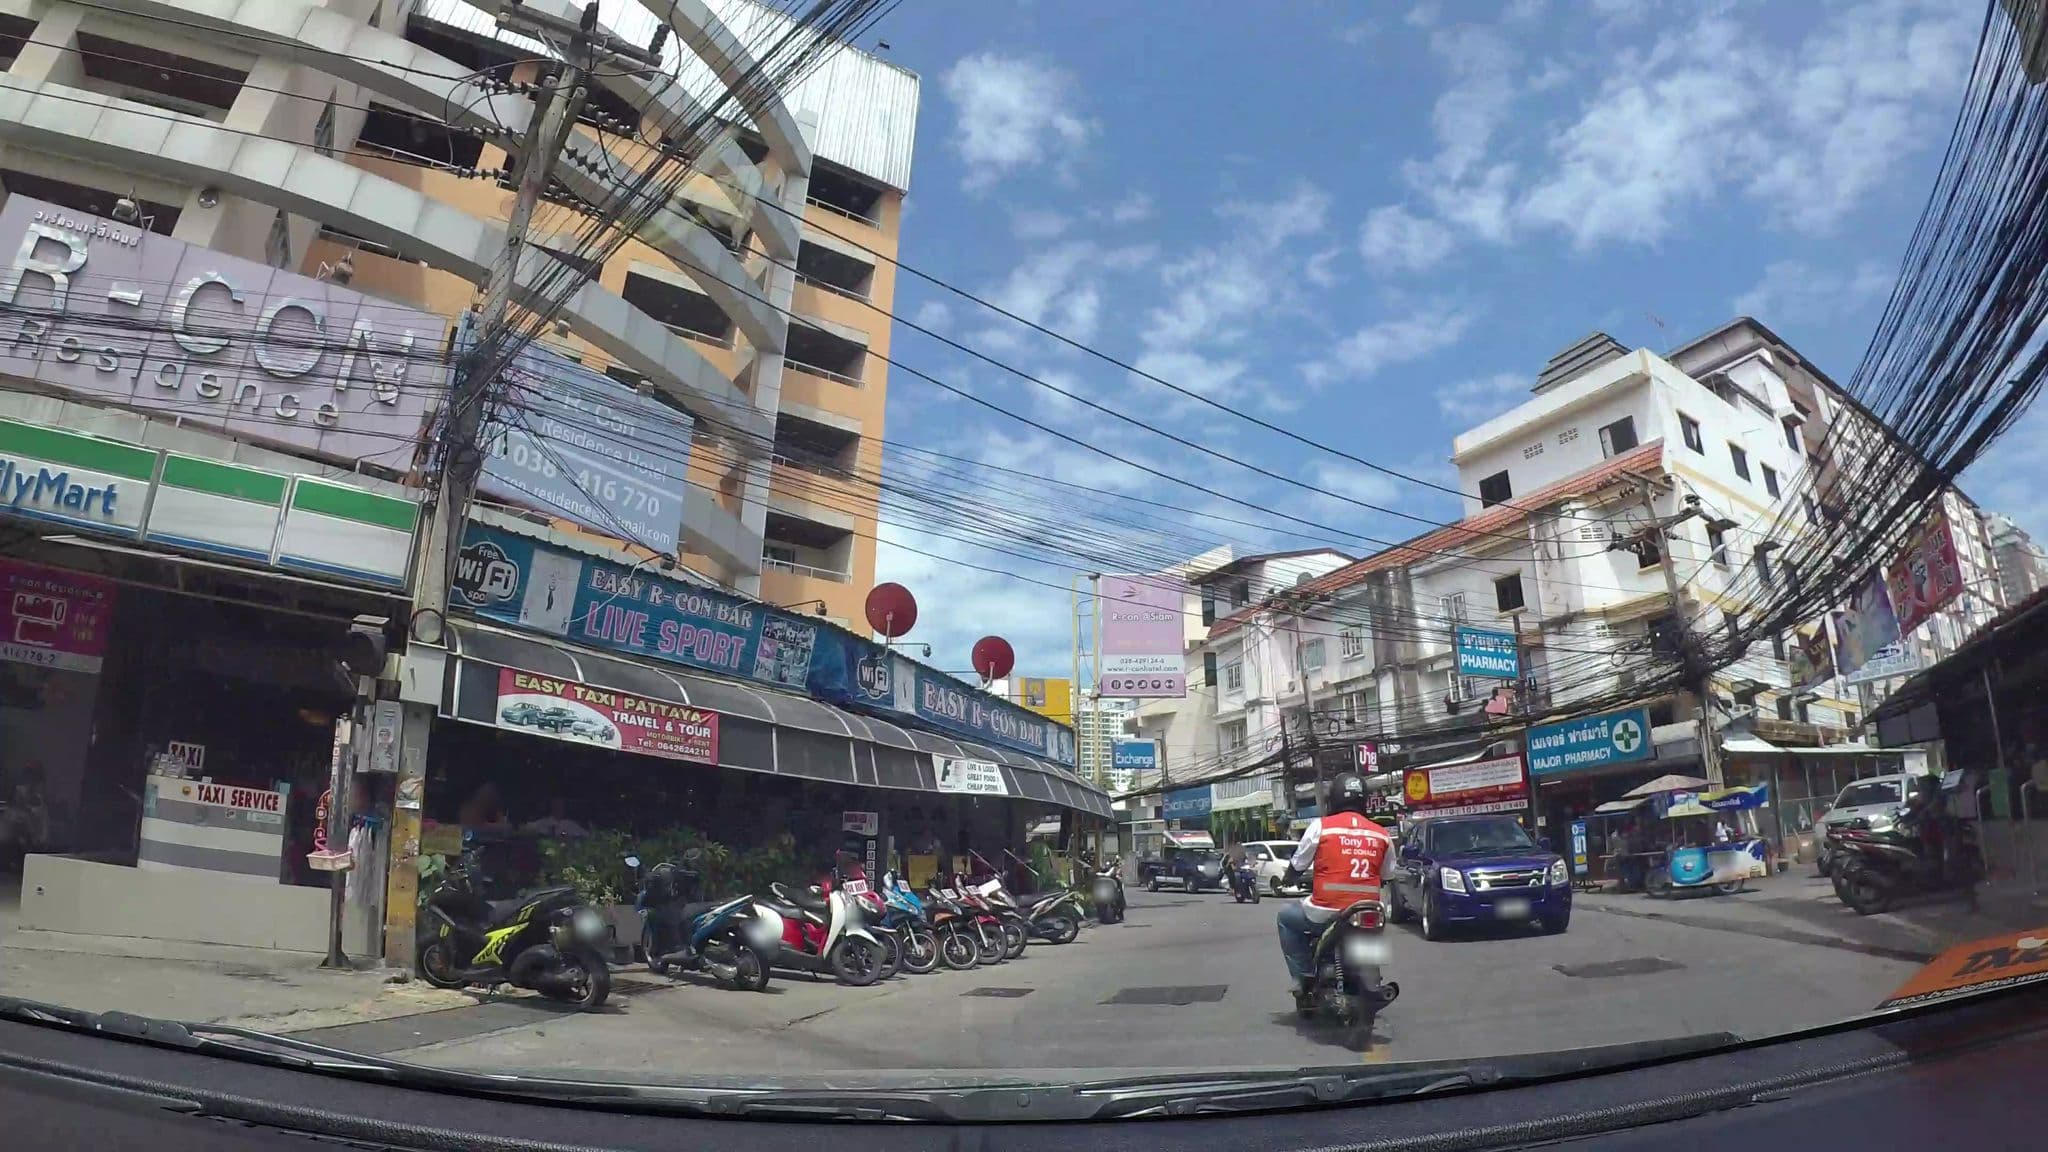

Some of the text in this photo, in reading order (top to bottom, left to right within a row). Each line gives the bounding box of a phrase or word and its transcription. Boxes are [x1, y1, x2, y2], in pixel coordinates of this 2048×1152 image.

[2, 222, 416, 406] R-CON
[10, 319, 338, 427] Residence
[542, 418, 667, 483] Residence Hotel
[578, 469, 617, 502] 416
[623, 486, 660, 517] 770
[478, 546, 498, 558] Free
[590, 568, 753, 629] EASY R-CON BAR
[1112, 612, 1139, 621] R-con
[584, 601, 747, 669] LIVE SPORT
[1460, 653, 1517, 673] PHARMACY
[515, 673, 702, 723] EASY TAXI PATTAYA
[612, 711, 711, 738] TRAVEL & TOUR
[922, 679, 1043, 747] EASY R-CON BAR
[170, 743, 201, 767] TAXI
[638, 738, 654, 747] Tel:
[1533, 746, 1611, 770] MAJOR PHARMACY
[197, 784, 279, 812] TAXI SERVICE
[1339, 835, 1362, 848] Tony
[1350, 858, 1370, 878] 22
